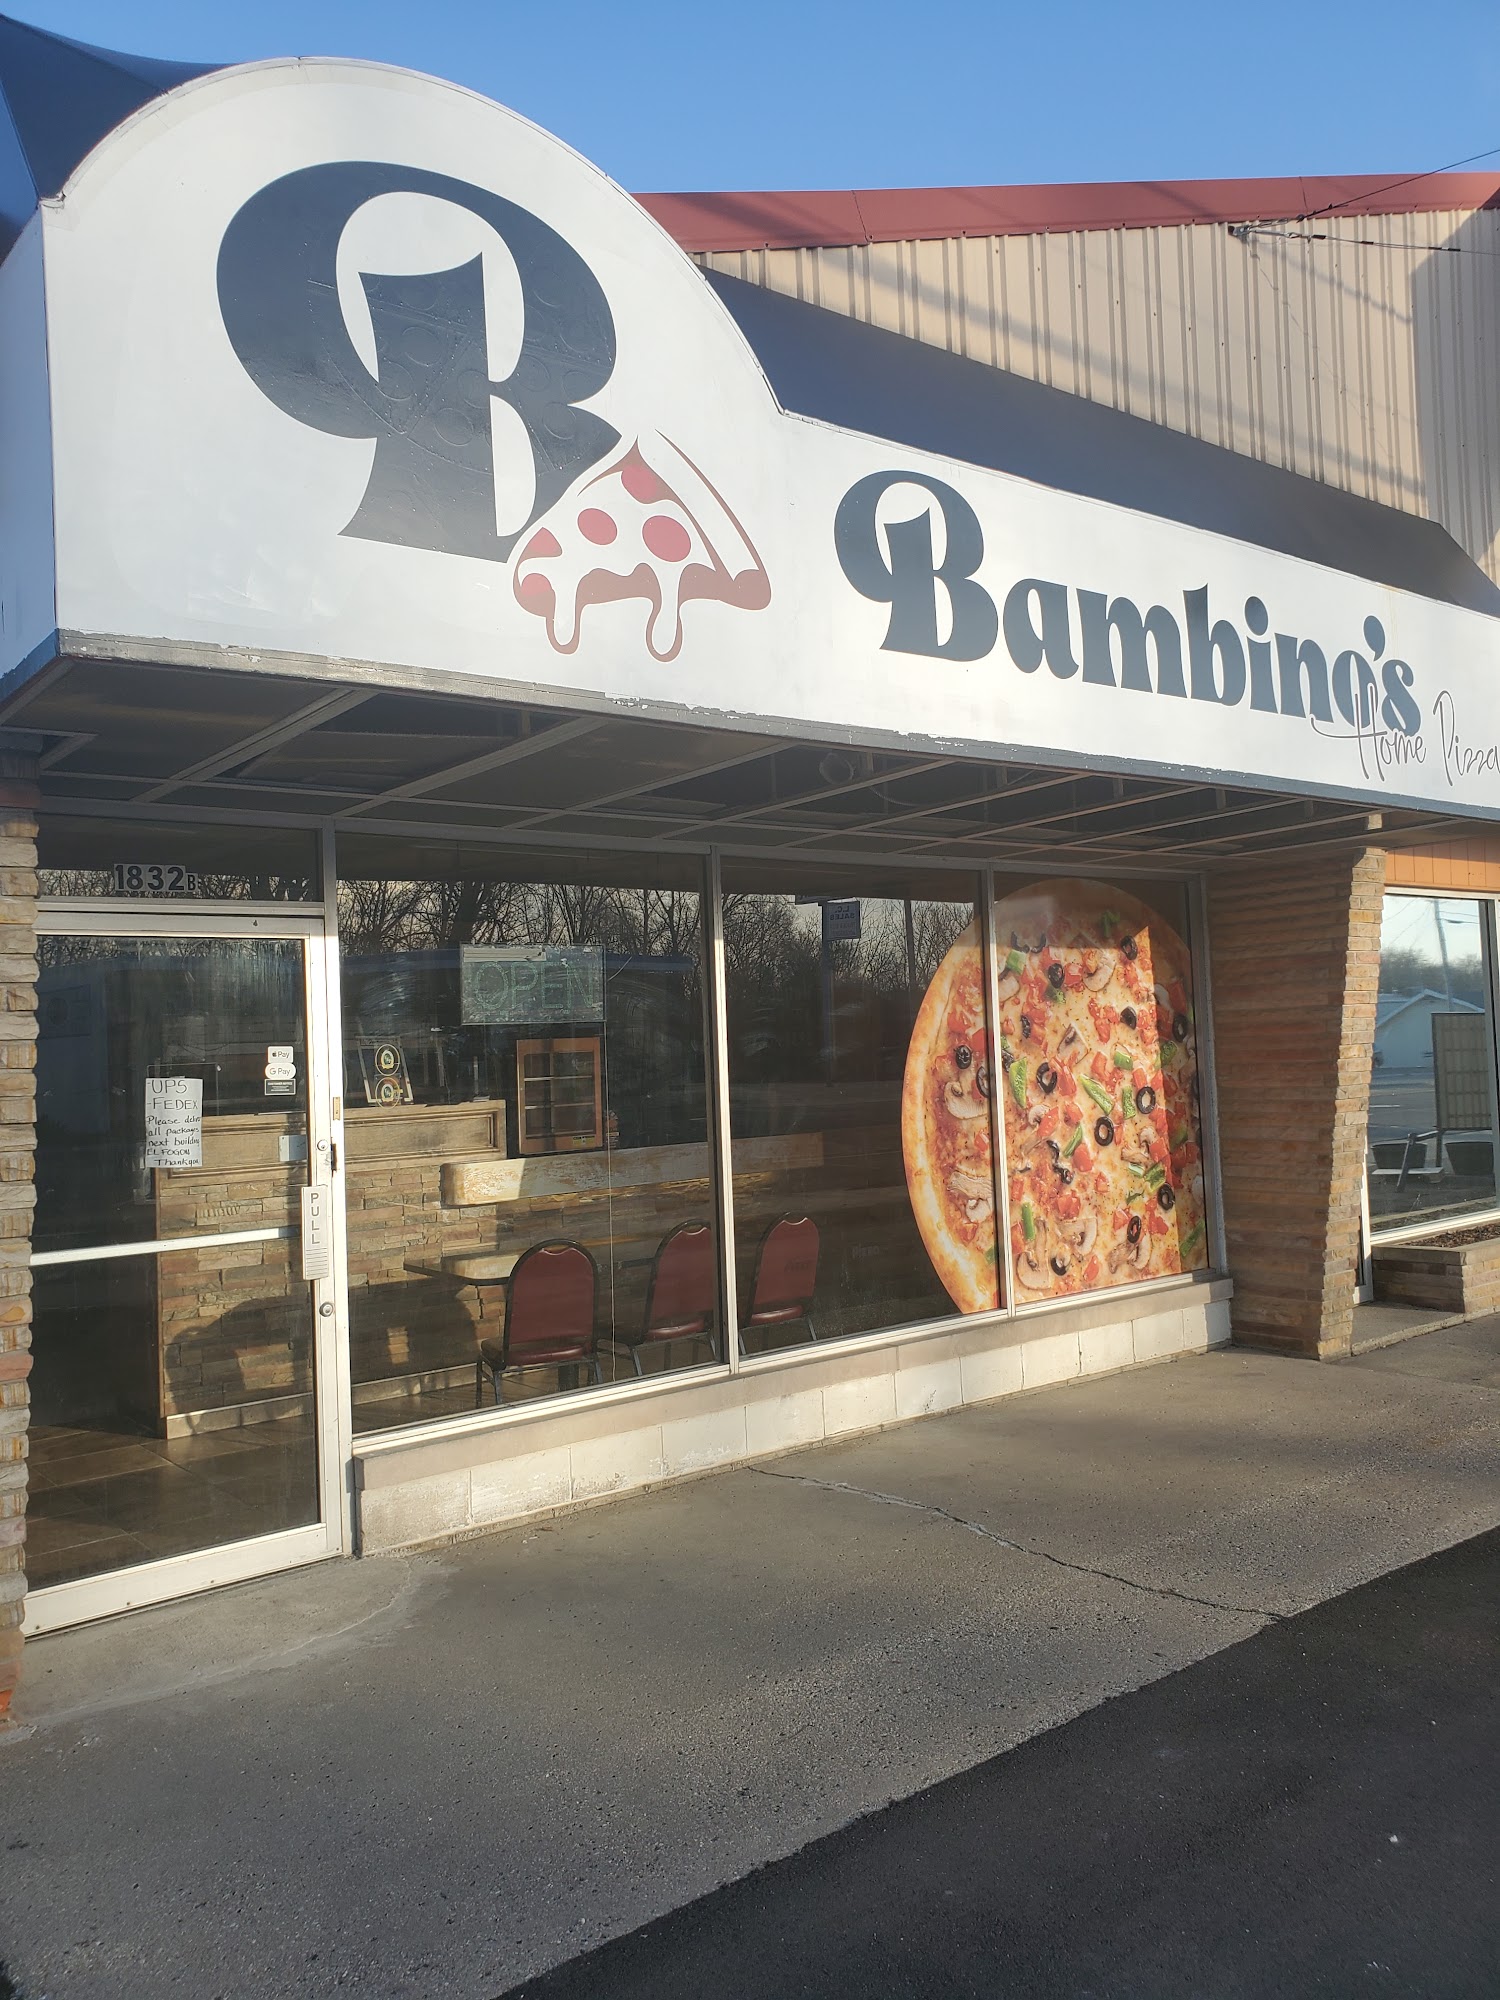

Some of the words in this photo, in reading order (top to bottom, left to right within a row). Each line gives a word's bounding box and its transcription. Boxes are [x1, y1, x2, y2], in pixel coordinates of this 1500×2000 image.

[217, 161, 622, 563] B
[834, 470, 1421, 737] Bambino's
[1311, 686, 1426, 781] Home
[475, 961, 593, 1011] OPEN
[277, 1051, 290, 1059] Pay
[269, 1067, 277, 1075] G
[277, 1067, 291, 1077] Pay
[146, 1115, 181, 1126] Please
[148, 1126, 161, 1136] all
[148, 1138, 169, 1147] next
[310, 1192, 321, 1245] PULL
